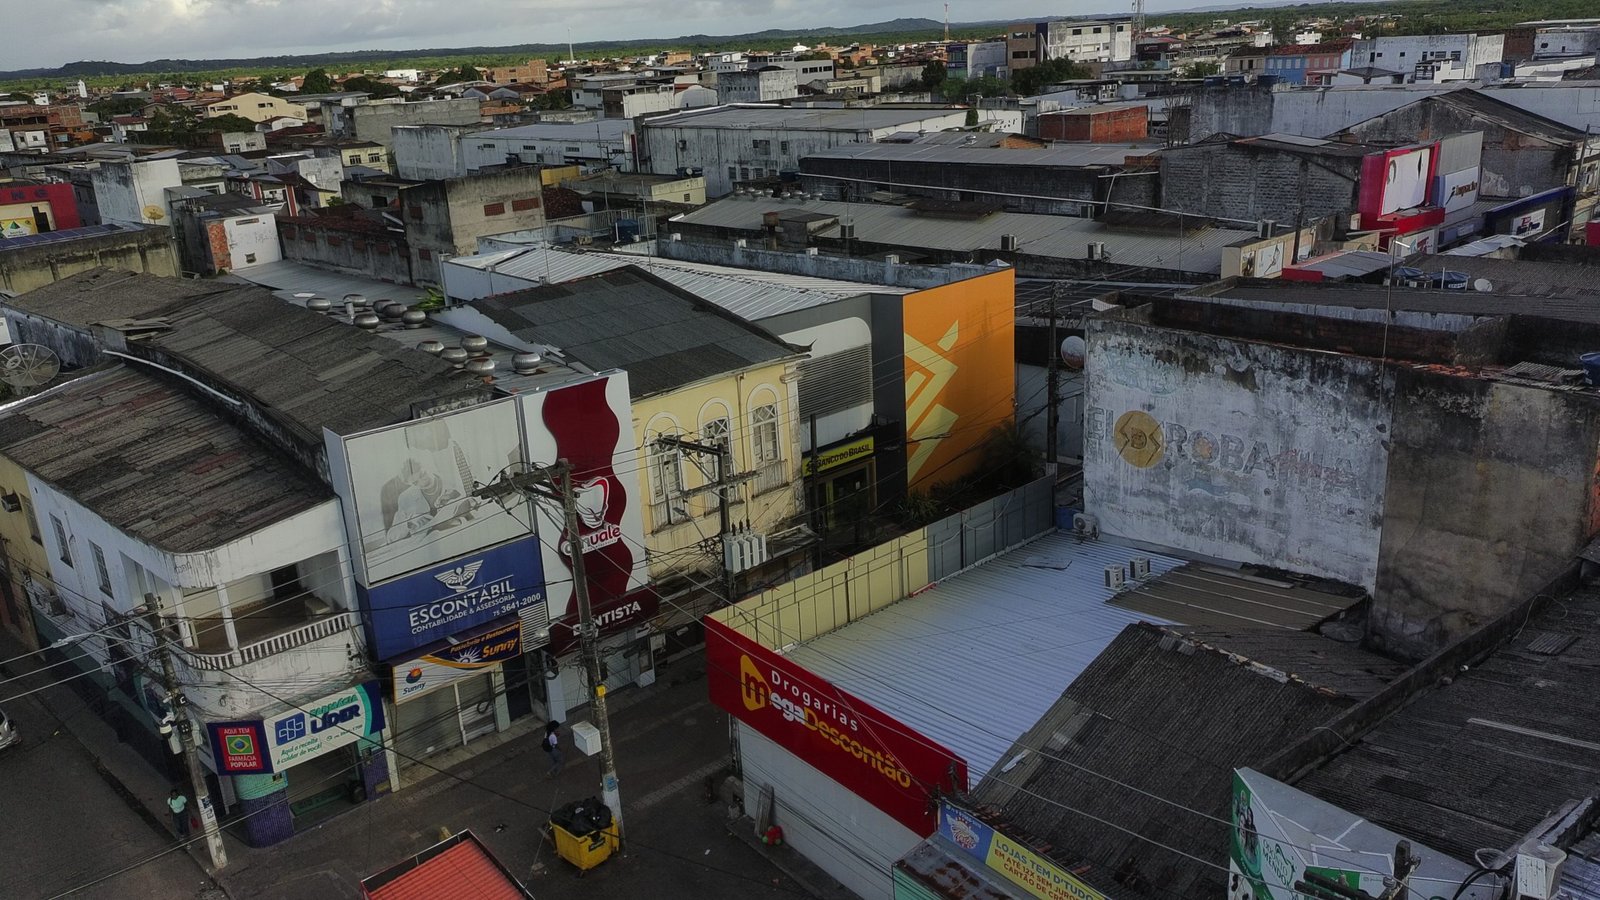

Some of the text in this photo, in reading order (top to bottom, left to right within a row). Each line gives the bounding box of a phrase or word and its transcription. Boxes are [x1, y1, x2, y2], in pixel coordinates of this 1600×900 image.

[816, 444, 870, 468] BANCO DO BRASIL
[409, 580, 516, 627] ESCONTÁBIL
[411, 610, 468, 635] CONTABILIDADE
[476, 594, 515, 612] ASSESSORIA
[501, 593, 541, 613] 3641-2000
[573, 601, 641, 637] DNTISTA
[482, 638, 518, 658] Sunny
[402, 681, 426, 695] Sunny
[771, 670, 858, 731] Drogarias
[310, 704, 361, 734] LÍDER
[994, 849, 1005, 860] EM
[1006, 857, 1020, 870] ATÉ
[1022, 866, 1035, 878] 12X
[1036, 876, 1052, 889] SEM
[996, 839, 1028, 864] LOJAS
[1030, 859, 1050, 878] TEM
[1003, 863, 1034, 886] CARTÃO
[1036, 882, 1047, 893] DE
